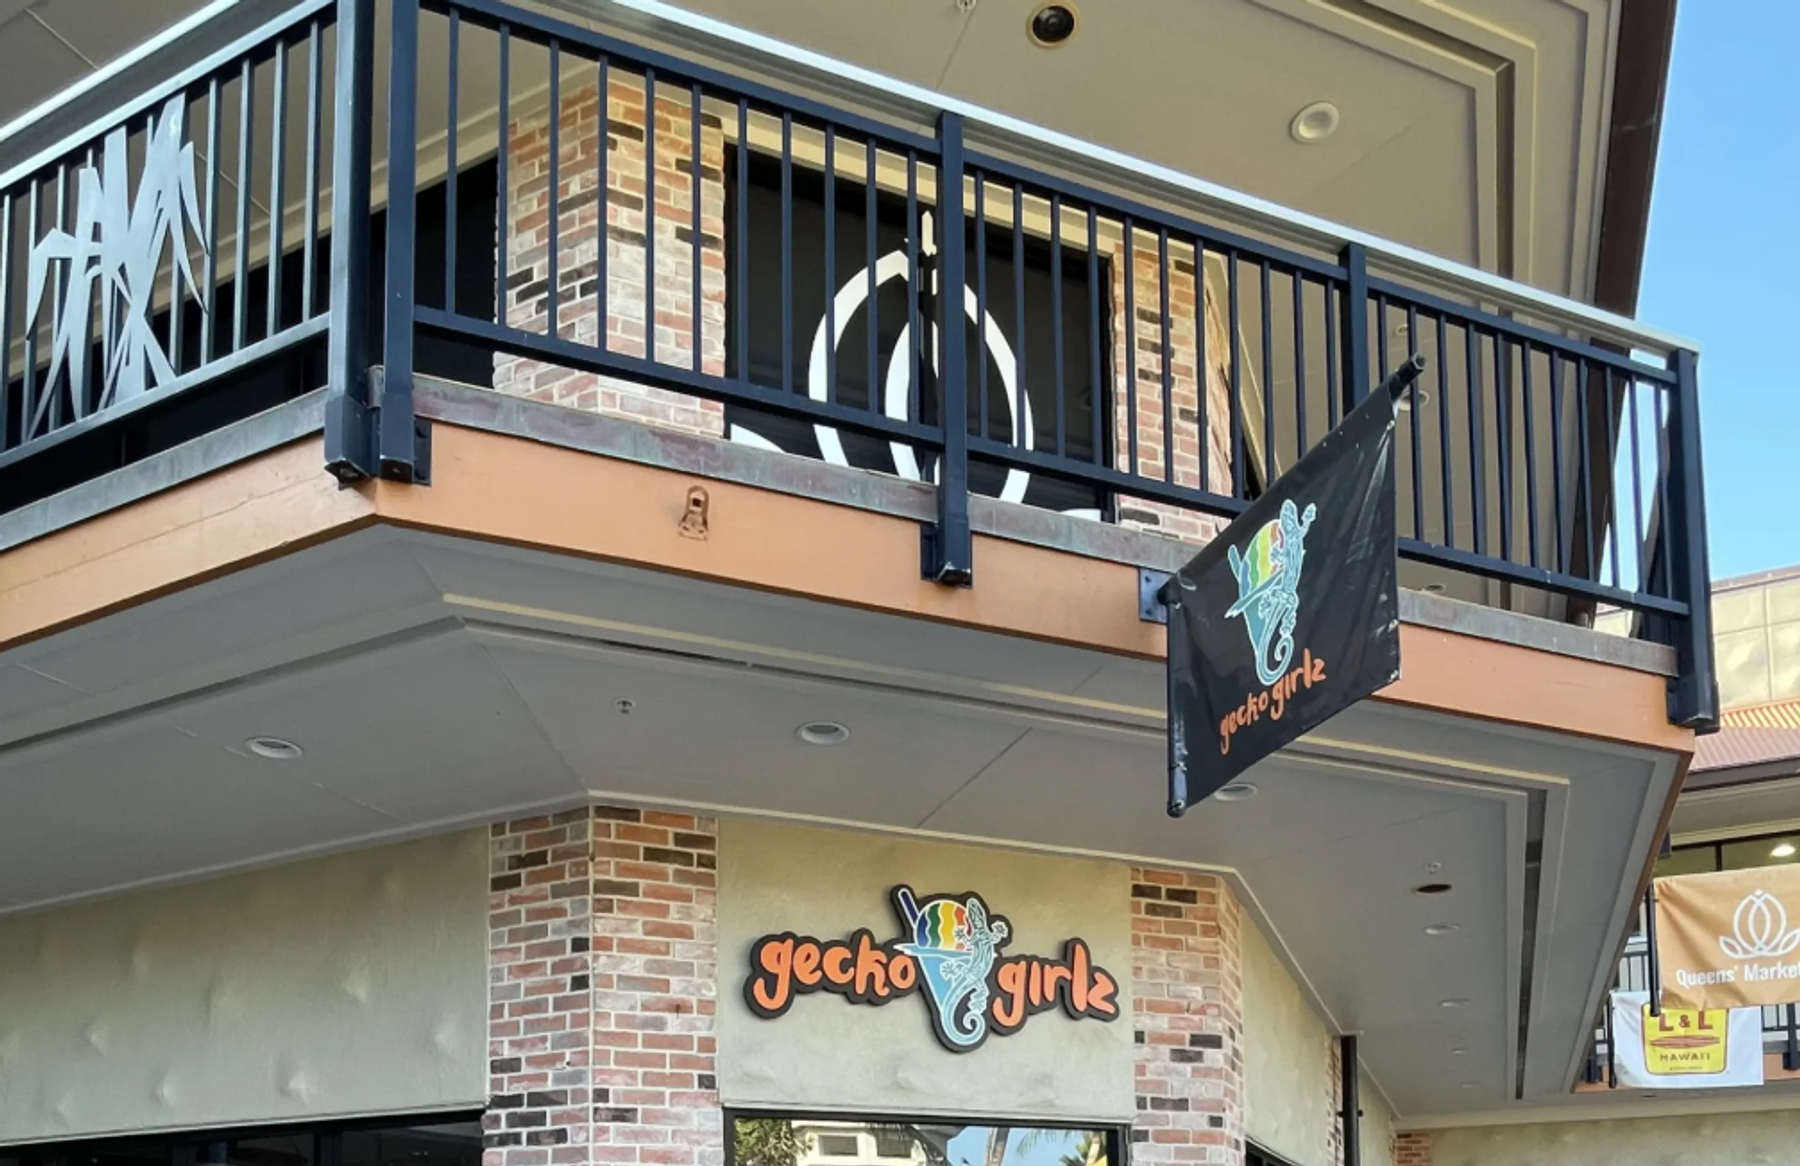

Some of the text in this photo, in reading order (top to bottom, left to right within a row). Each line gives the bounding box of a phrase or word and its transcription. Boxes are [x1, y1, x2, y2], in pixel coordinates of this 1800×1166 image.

[1219, 648, 1327, 756] gecko girlz
[752, 933, 1118, 1028] gecko girlz
[1675, 965, 1738, 989] Queens'
[1659, 1010, 1713, 1031] L & L
